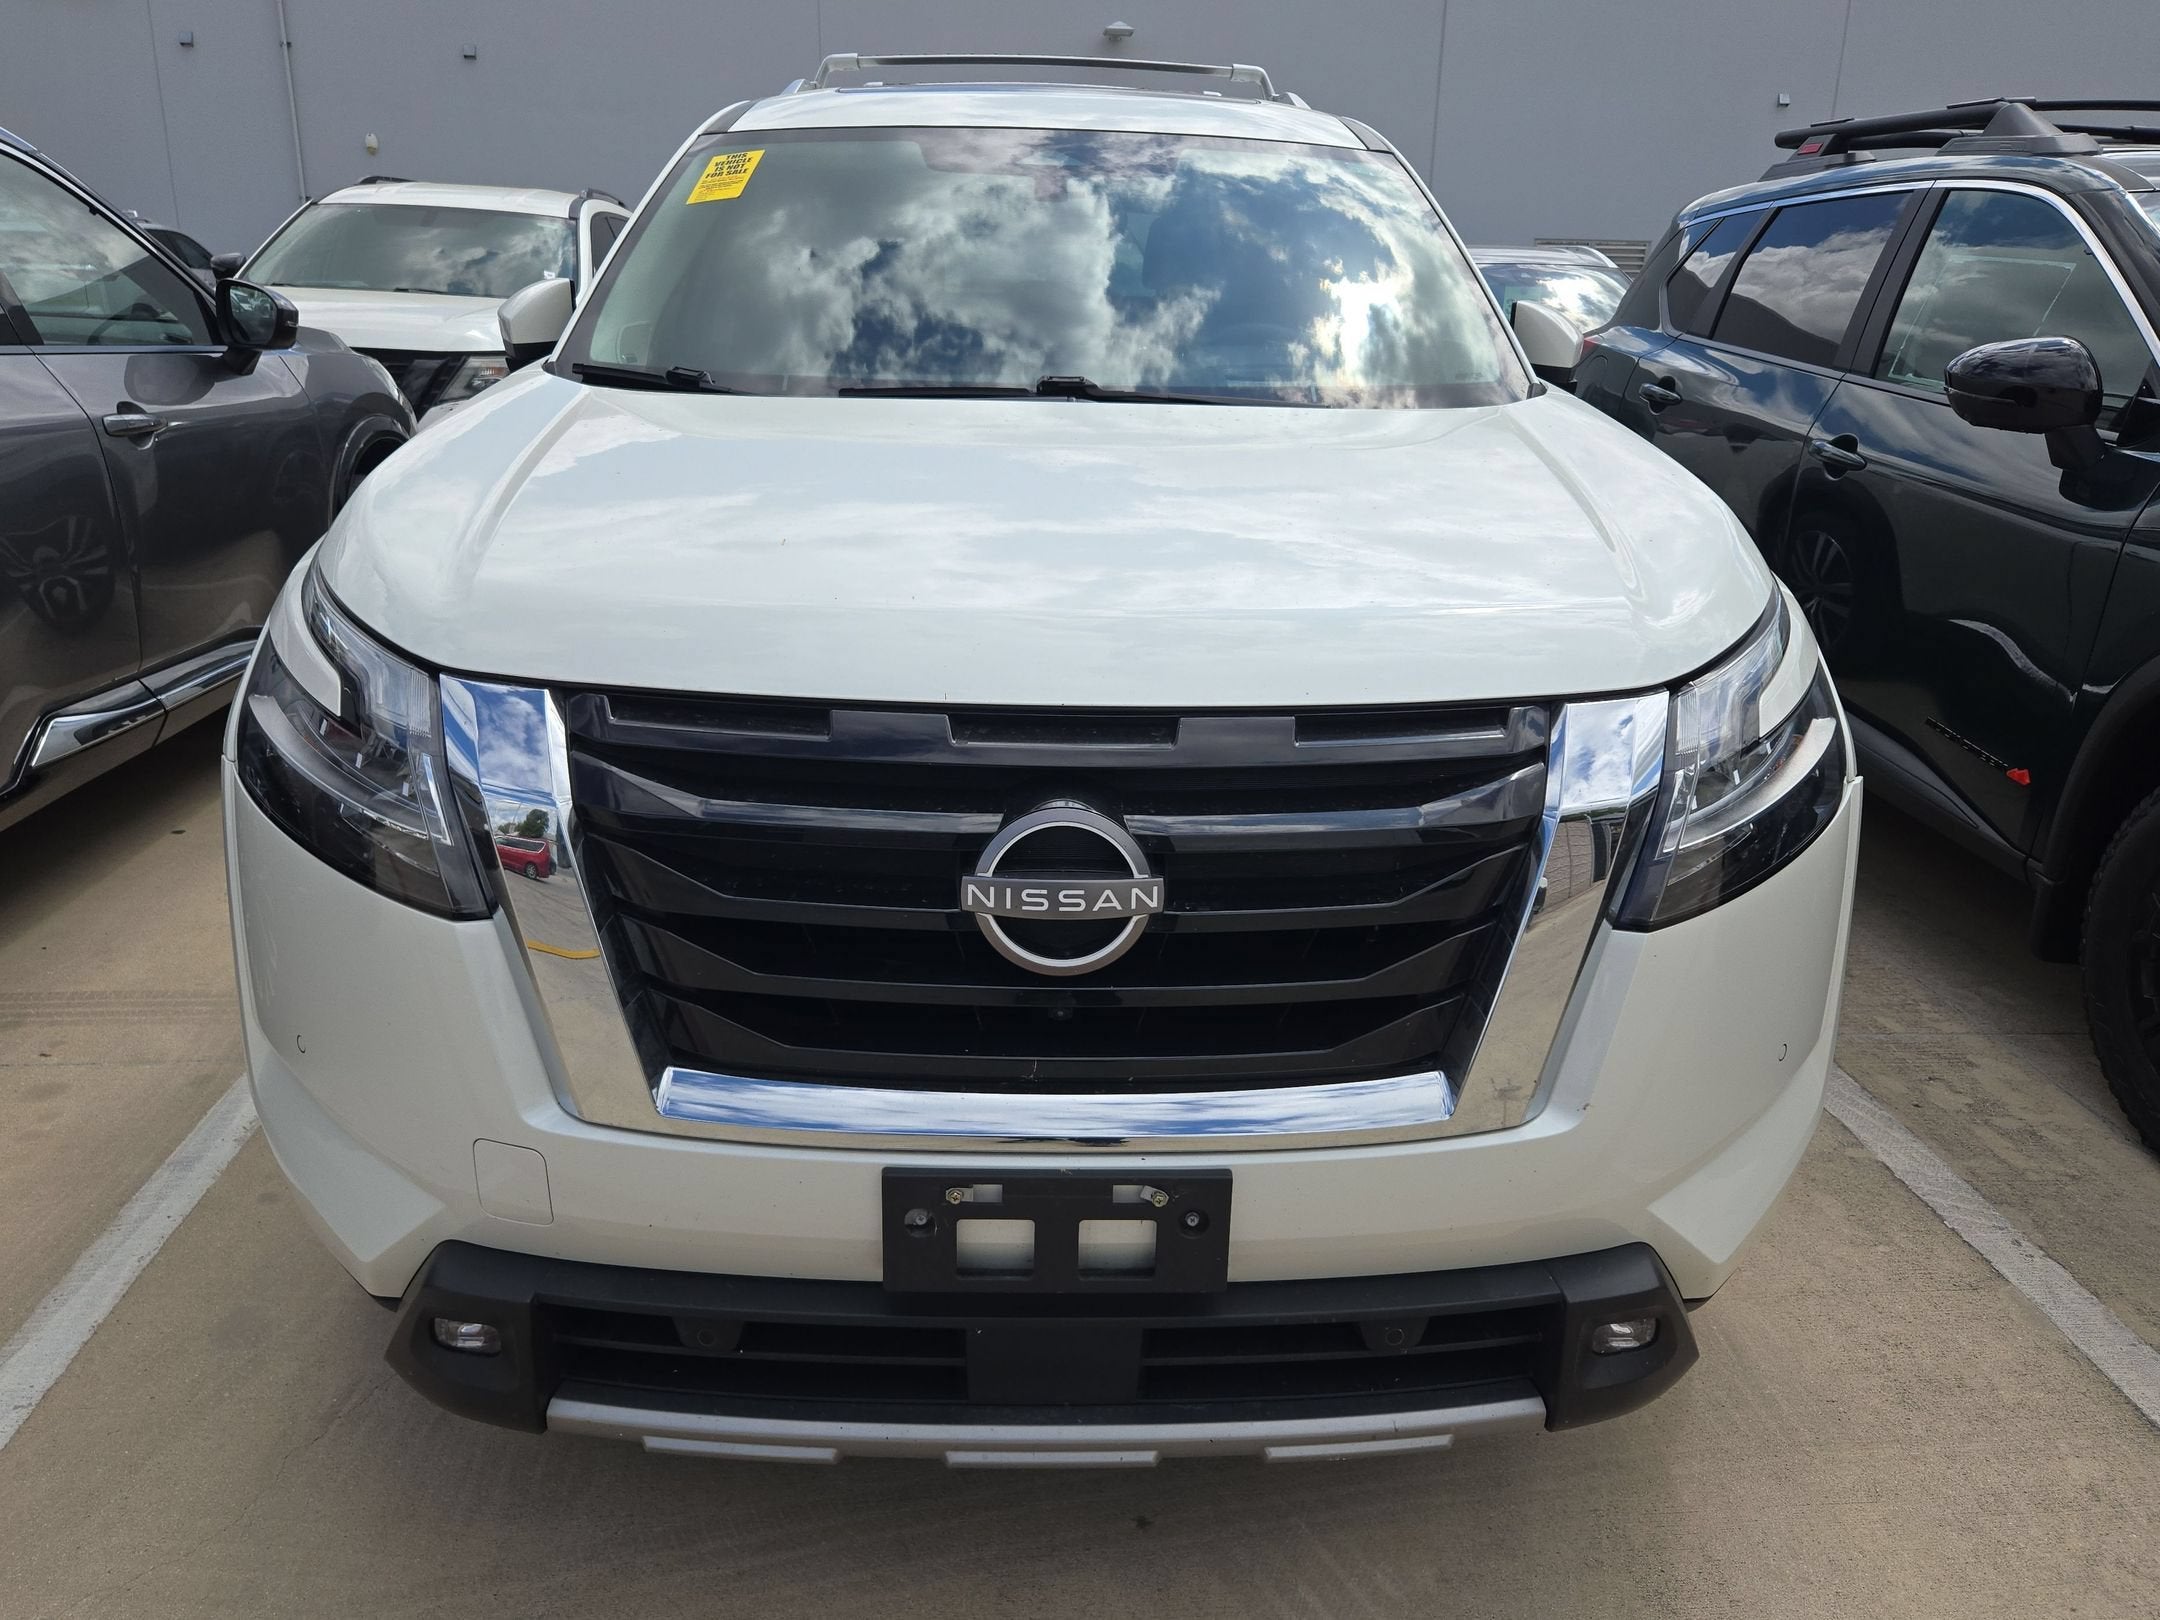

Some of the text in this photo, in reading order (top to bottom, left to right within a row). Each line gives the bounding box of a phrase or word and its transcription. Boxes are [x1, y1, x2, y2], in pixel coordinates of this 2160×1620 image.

[726, 152, 748, 160] THIS
[715, 157, 752, 166] VEHICLE
[726, 163, 745, 171] NOT
[705, 168, 748, 179] FOR SALE
[967, 884, 1158, 912] NISSAN
